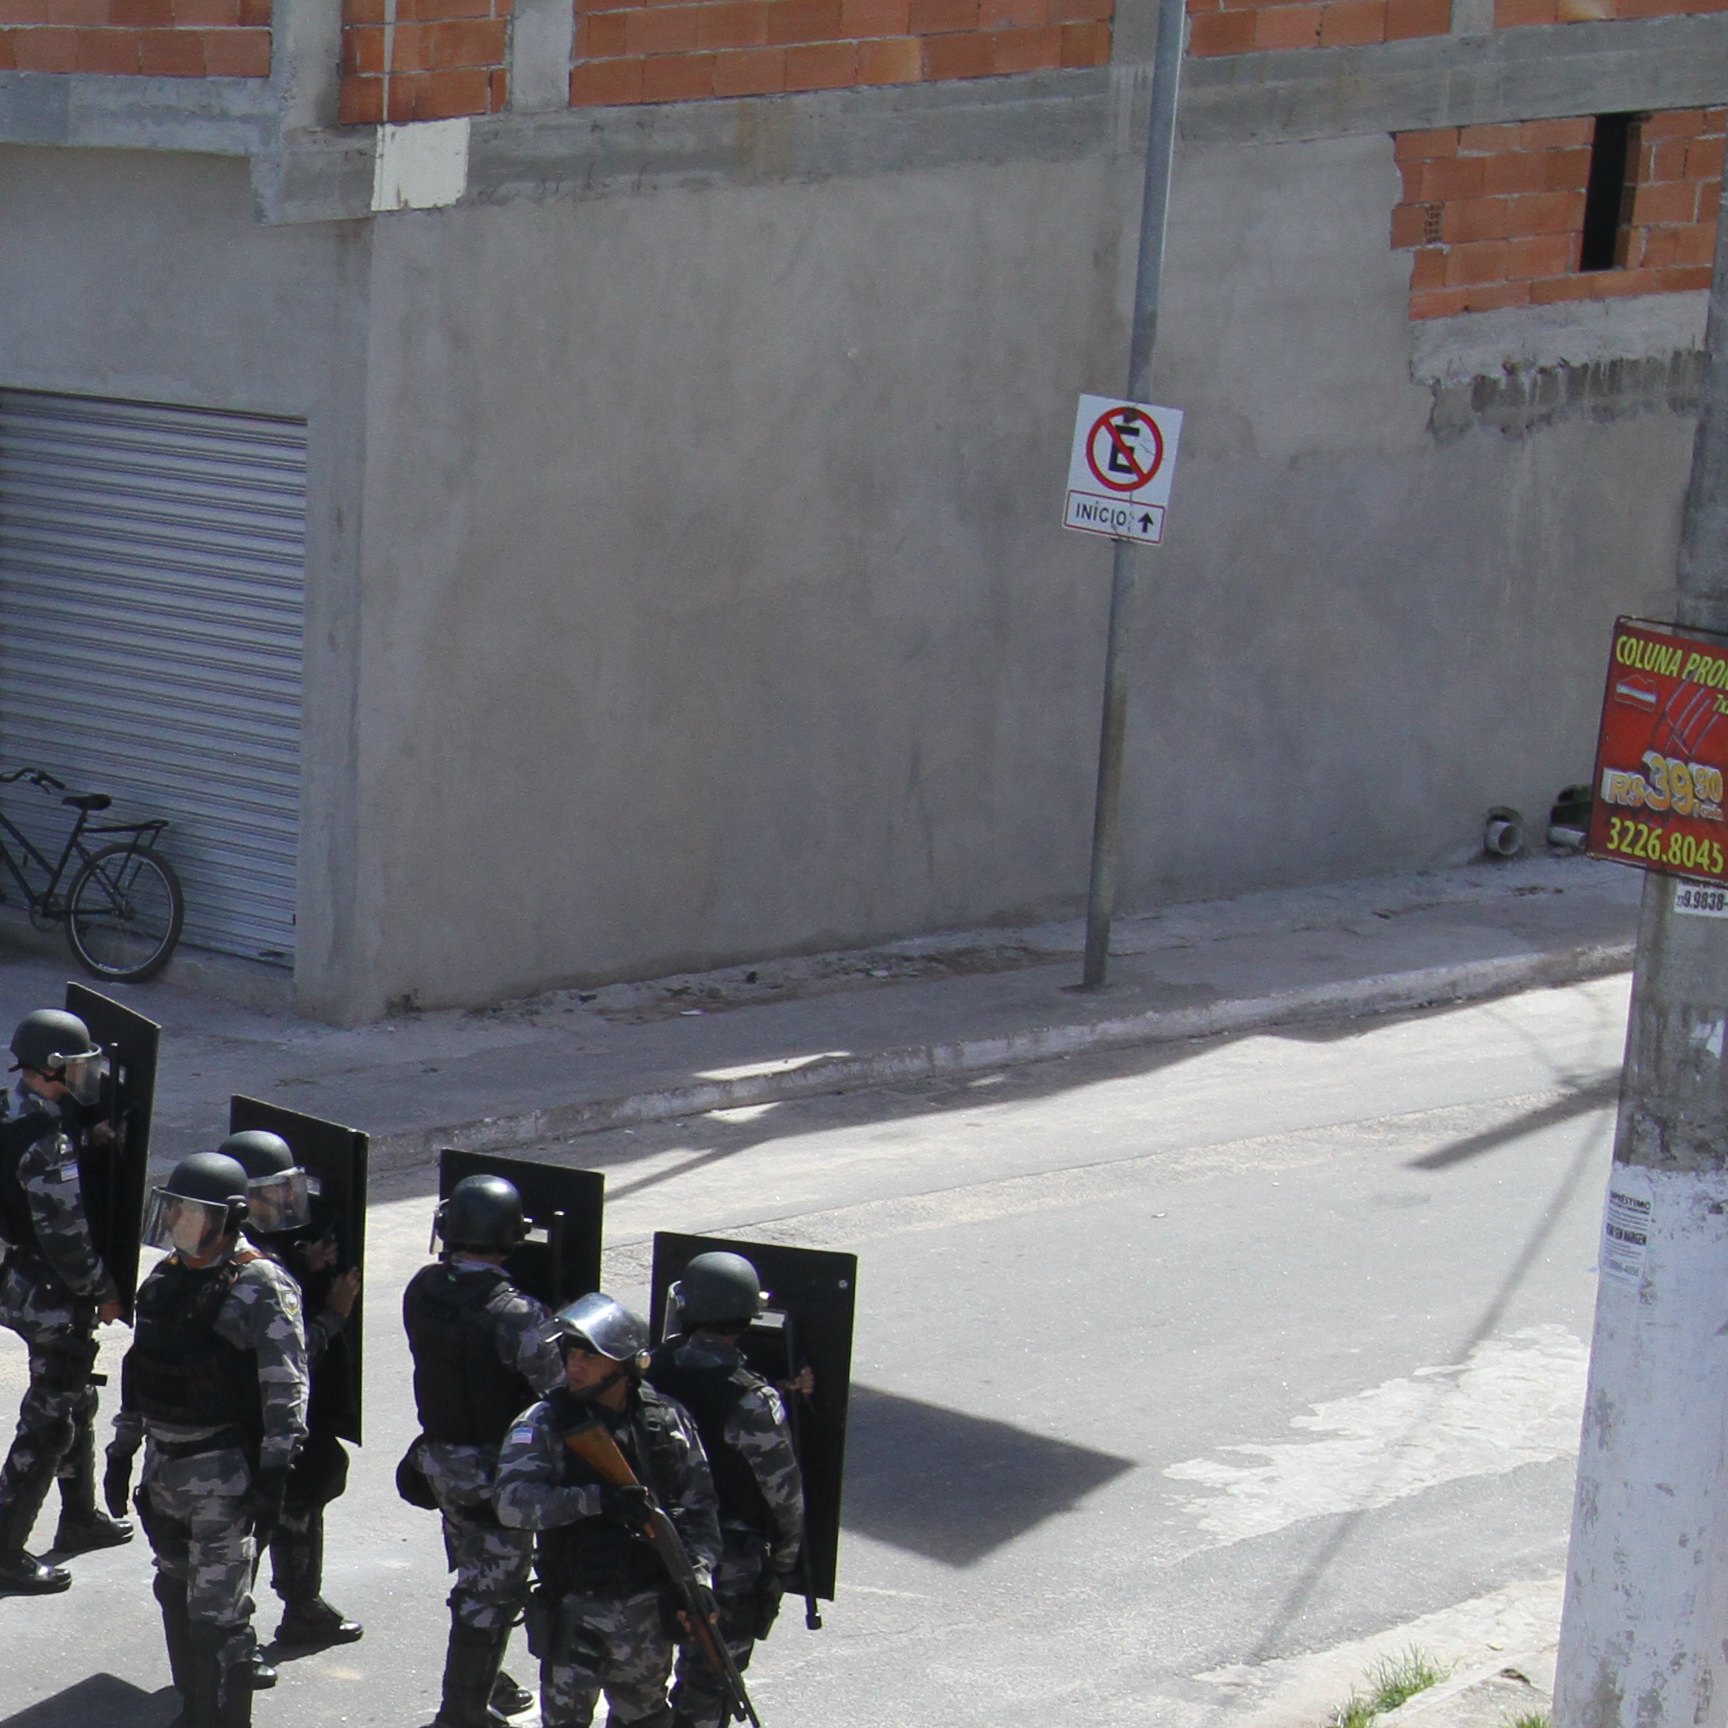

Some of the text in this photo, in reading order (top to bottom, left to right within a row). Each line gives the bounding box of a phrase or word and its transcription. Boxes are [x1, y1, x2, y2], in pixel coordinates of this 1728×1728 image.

[1075, 501, 1127, 527] INÍCIO
[1616, 635, 1683, 678] COLUNA
[1606, 816, 1724, 873] 3226.8045
